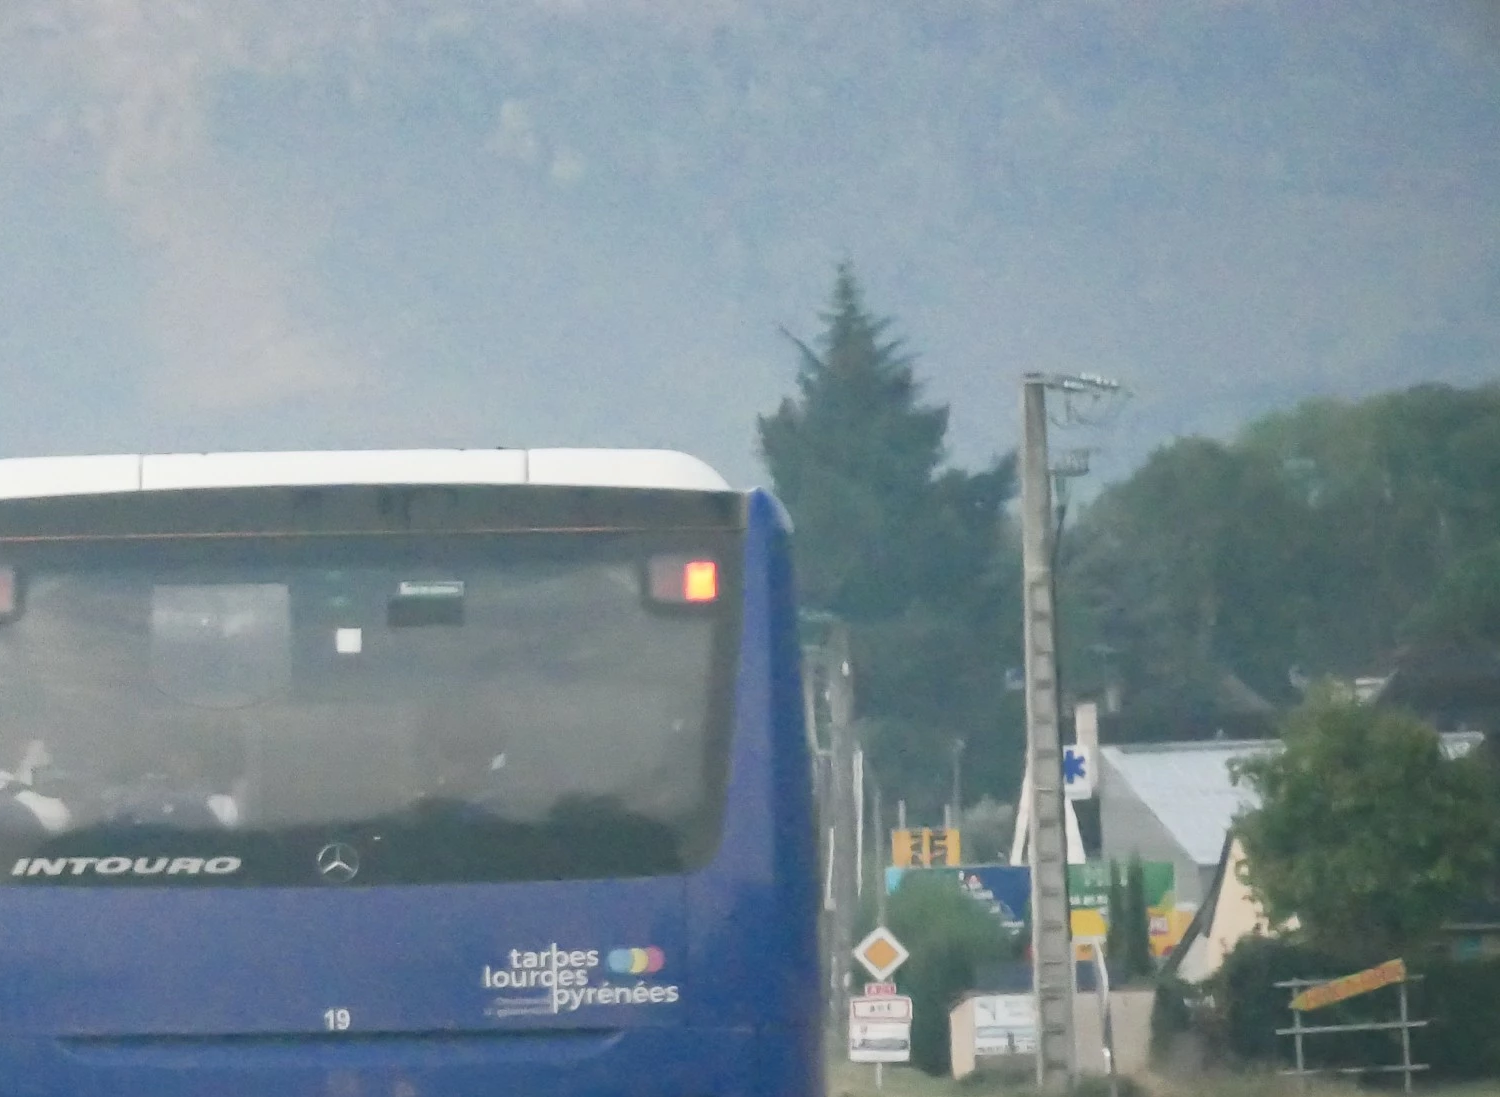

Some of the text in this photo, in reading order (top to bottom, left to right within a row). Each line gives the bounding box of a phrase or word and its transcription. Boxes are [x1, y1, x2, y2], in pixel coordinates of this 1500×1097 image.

[11, 856, 243, 876] INTOURO
[510, 943, 599, 968] tarbes
[485, 965, 589, 988] lourdes
[553, 980, 680, 1013] pyrénées
[324, 1008, 350, 1031] 19
